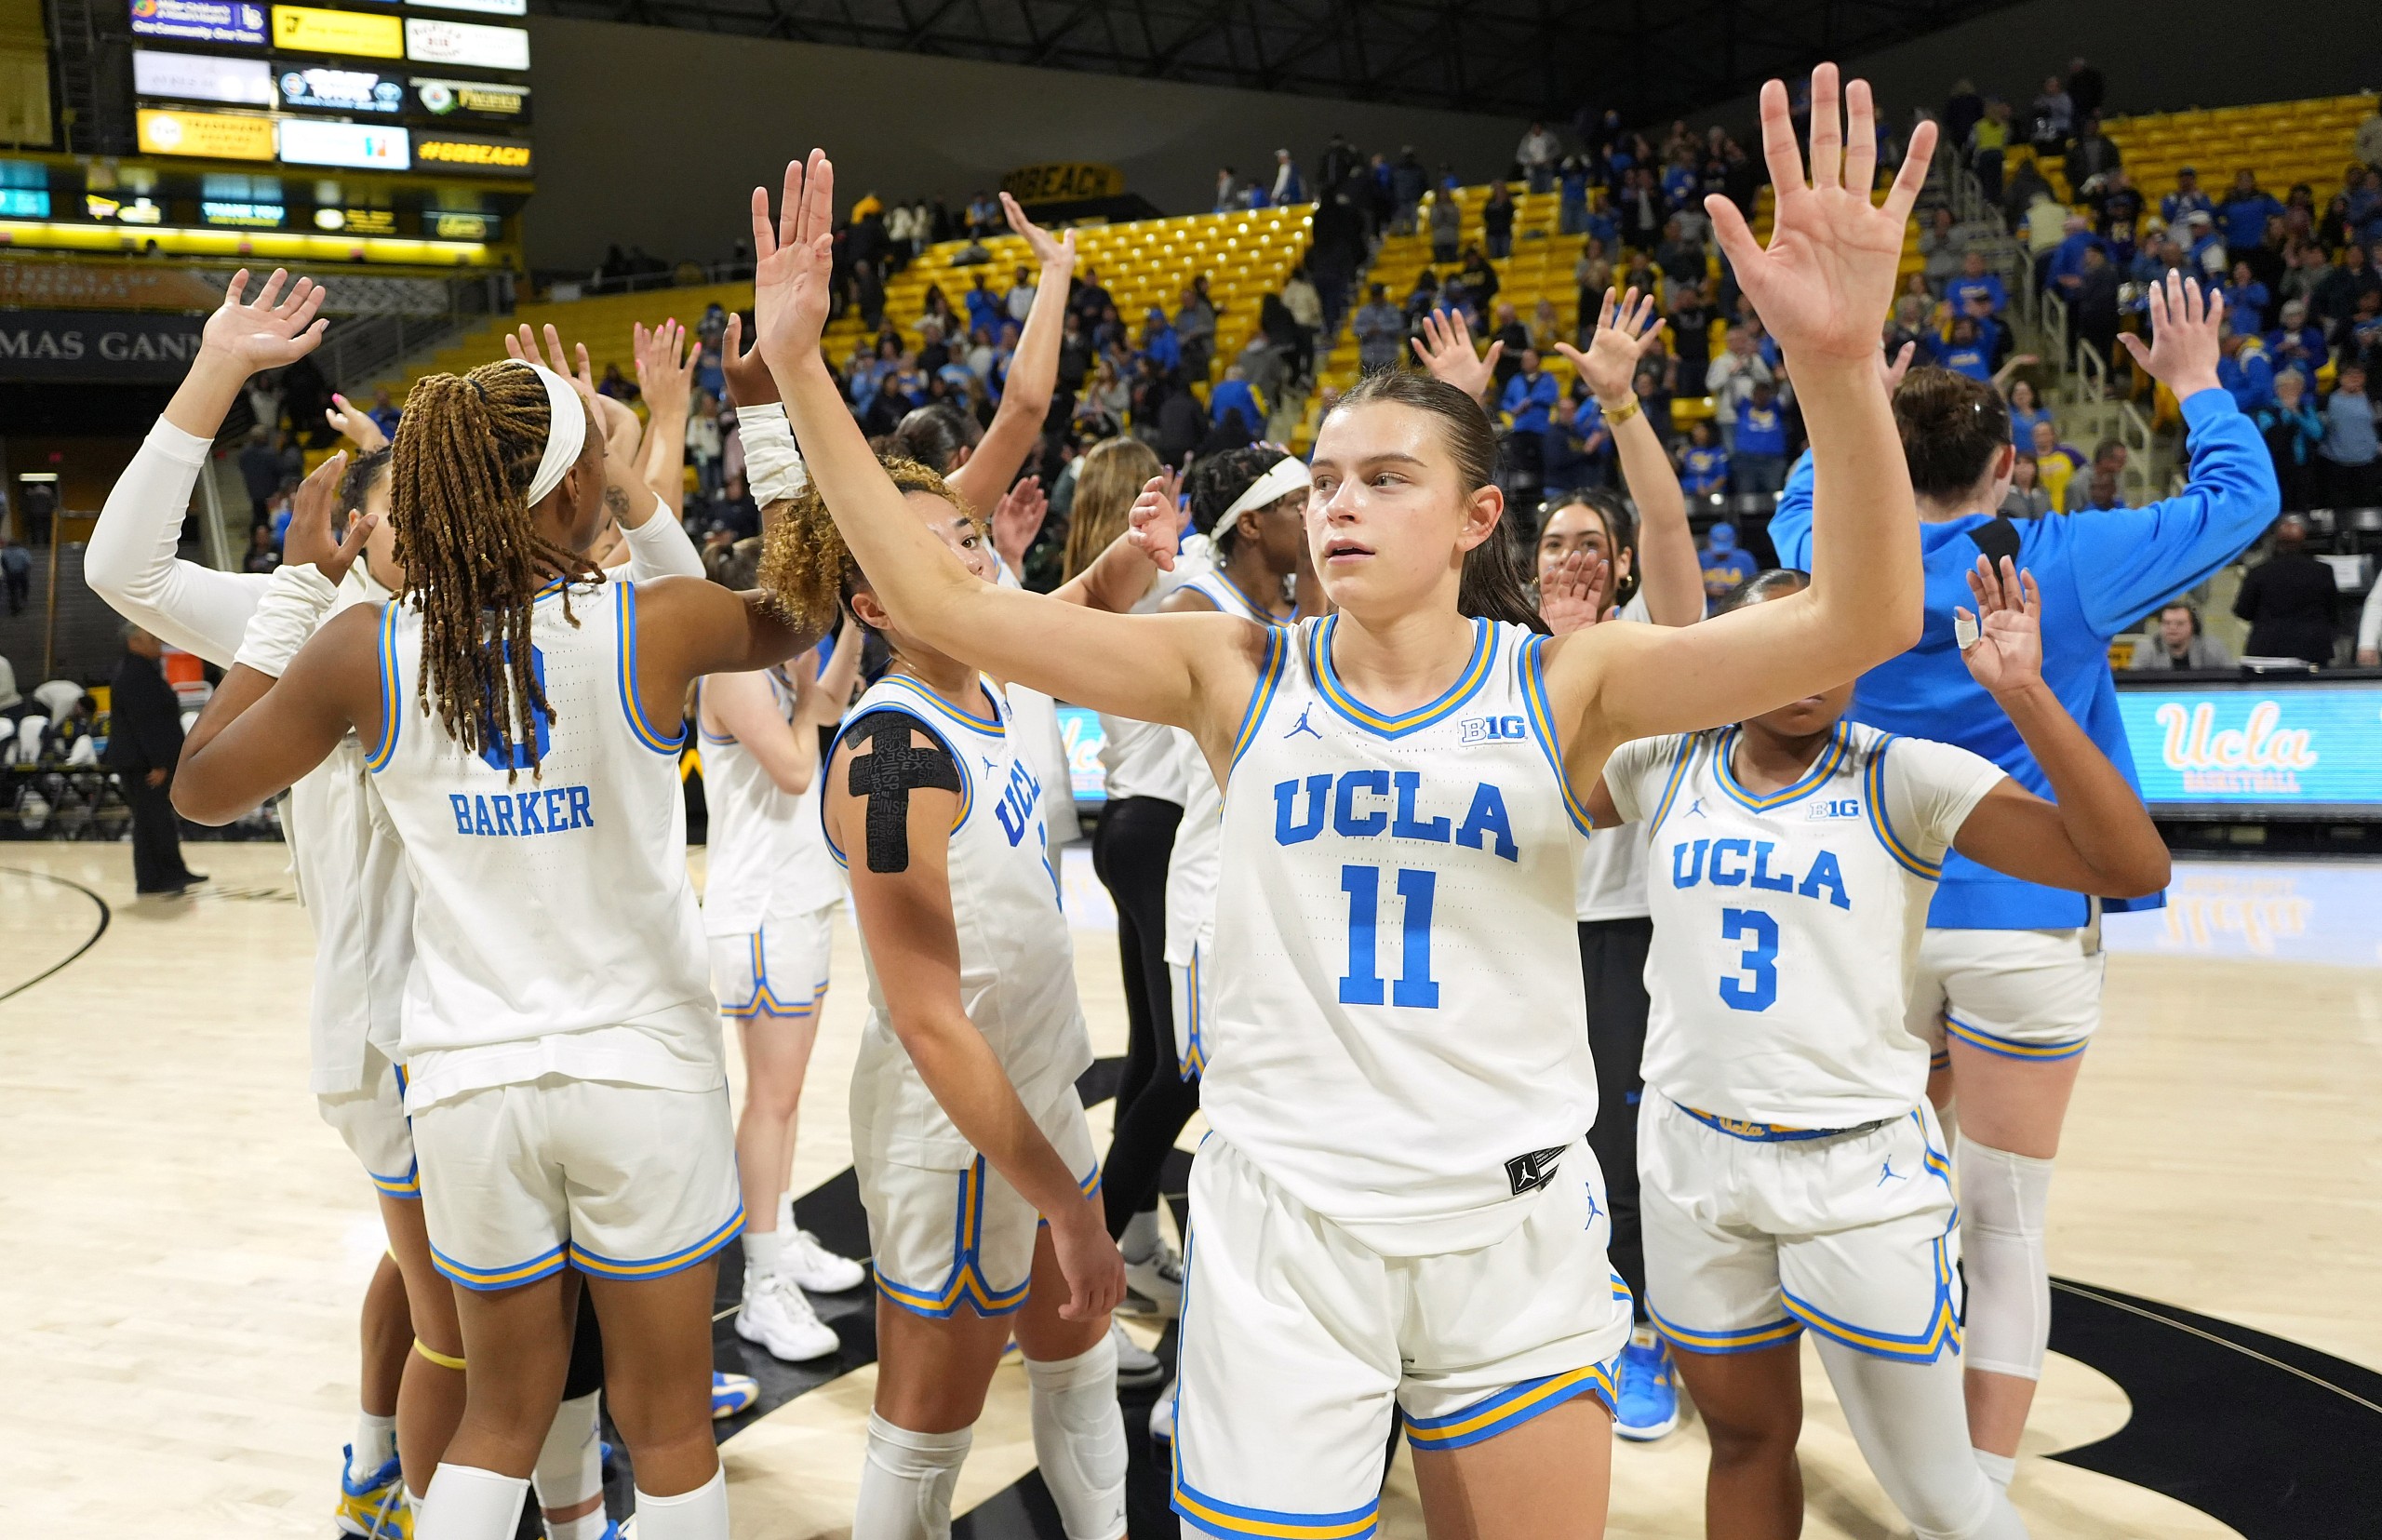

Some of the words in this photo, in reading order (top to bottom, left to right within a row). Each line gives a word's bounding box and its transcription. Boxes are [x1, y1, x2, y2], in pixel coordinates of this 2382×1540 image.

[419, 141, 529, 167] #GOBEACH
[448, 785, 594, 837] BARKER
[995, 758, 1041, 848] UCL
[1274, 770, 1519, 864] UCLA
[2183, 770, 2301, 793] BASKETBALL
[1673, 838, 1851, 911] UCLA
[1339, 864, 1439, 1009] 11
[1719, 907, 1779, 1012] 3
